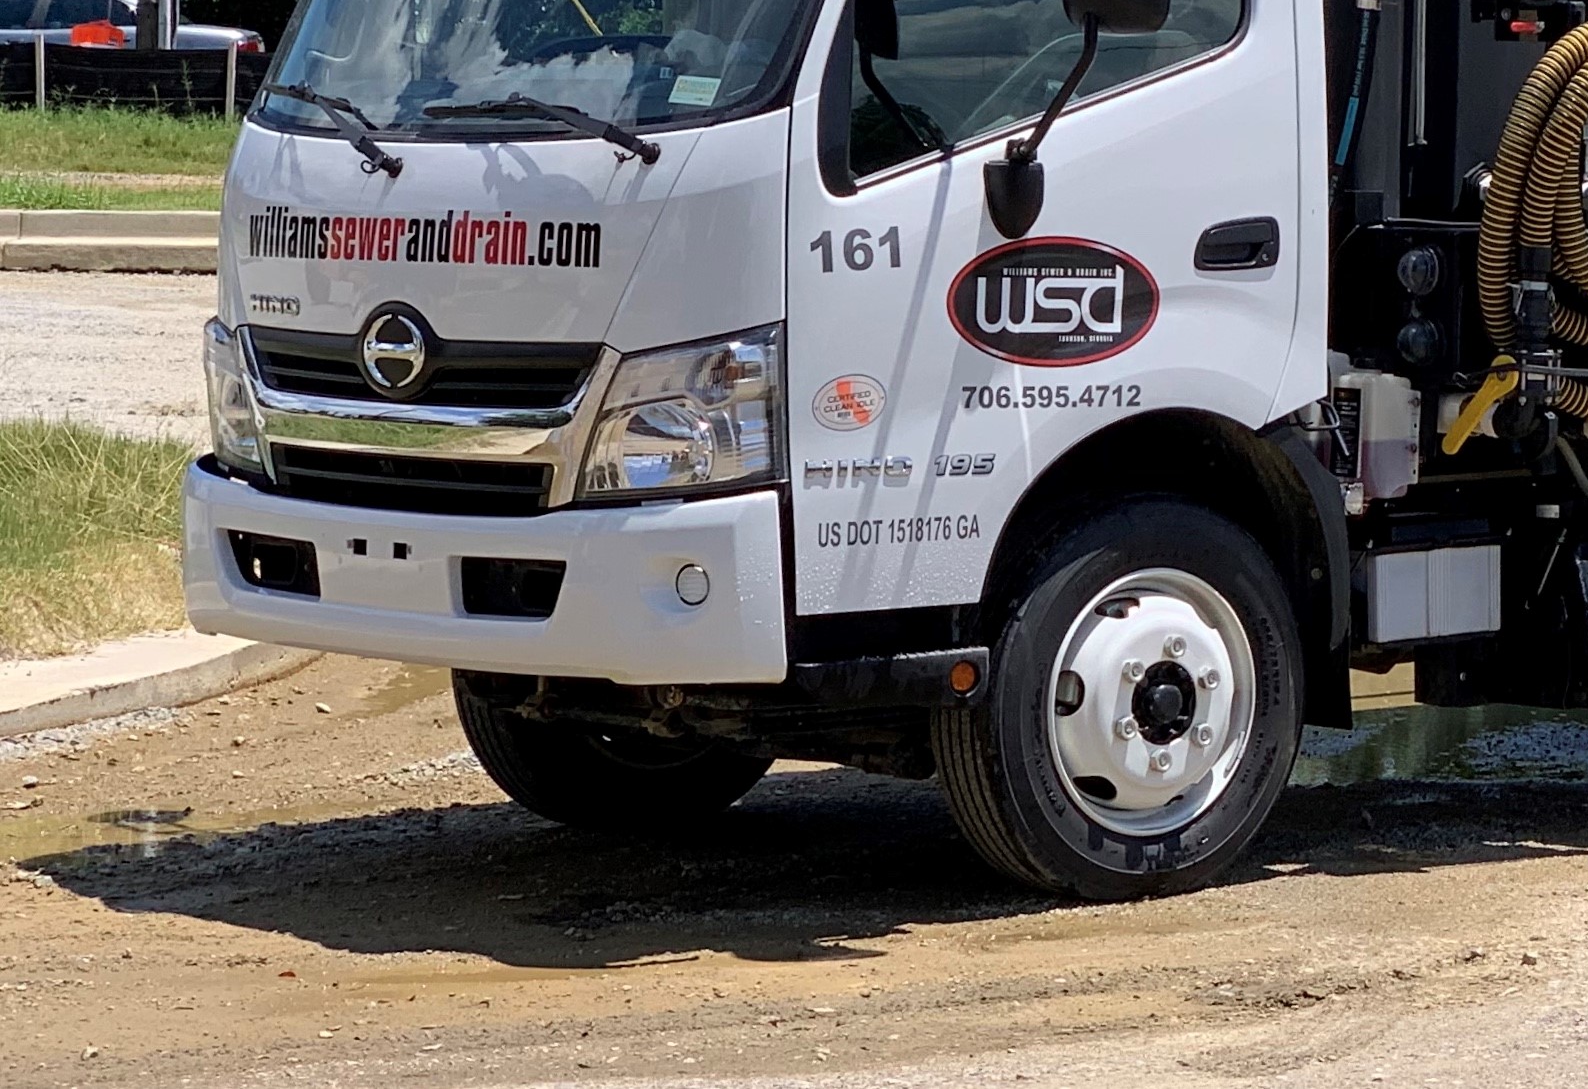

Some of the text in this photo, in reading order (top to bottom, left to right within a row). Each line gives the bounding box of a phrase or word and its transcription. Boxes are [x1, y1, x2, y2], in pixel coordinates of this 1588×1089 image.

[249, 206, 601, 268] williamsseweranddrain.com
[810, 225, 901, 273] 161
[824, 403, 853, 413] CLEAN
[827, 391, 871, 403] CERTIFIED
[962, 385, 1141, 409] 706.595.4712
[804, 453, 996, 478] HINO 195
[818, 514, 980, 547] US DOT 1518176 GA
